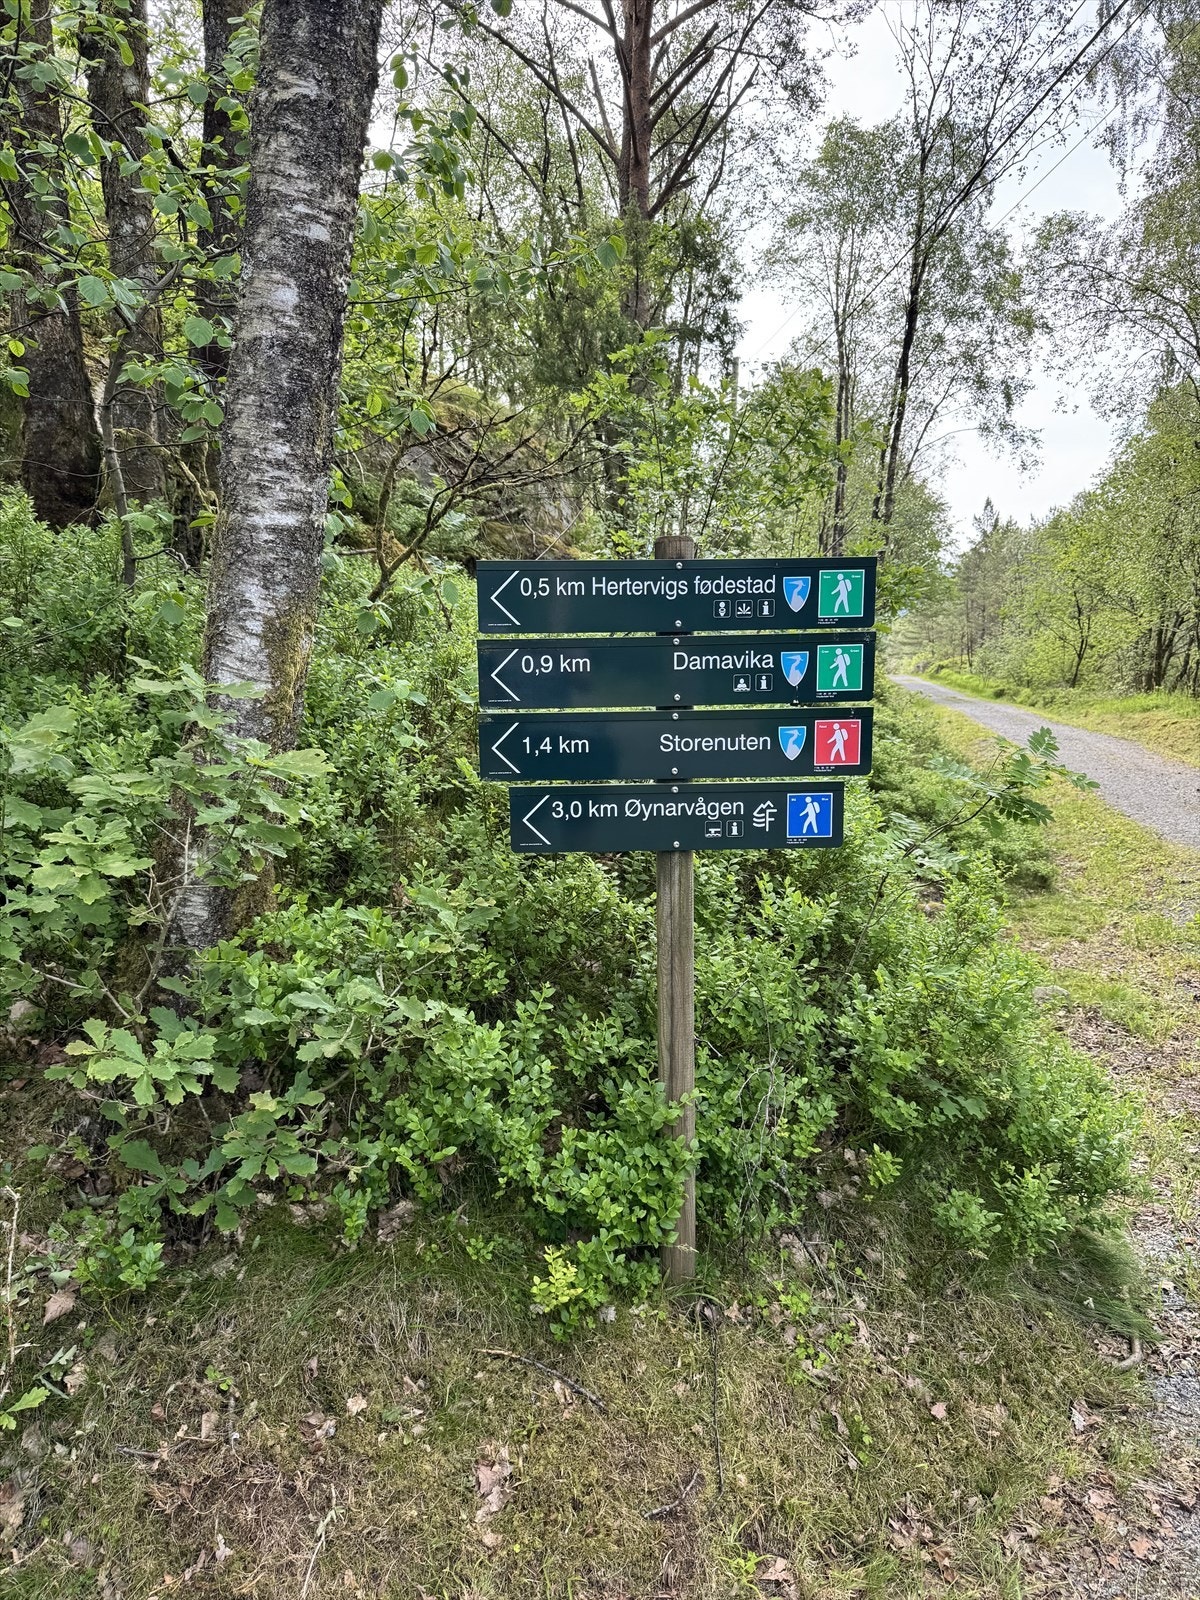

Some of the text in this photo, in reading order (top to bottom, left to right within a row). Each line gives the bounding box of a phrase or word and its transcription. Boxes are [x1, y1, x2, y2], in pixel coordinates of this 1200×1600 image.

[521, 574, 776, 600] 0,5 km Hertervigs fødestad
[521, 650, 775, 676] 0,9 km Damavika
[522, 733, 771, 757] 1,4 km Storenuten
[551, 796, 744, 822] 3,0 km Øynarvågen
